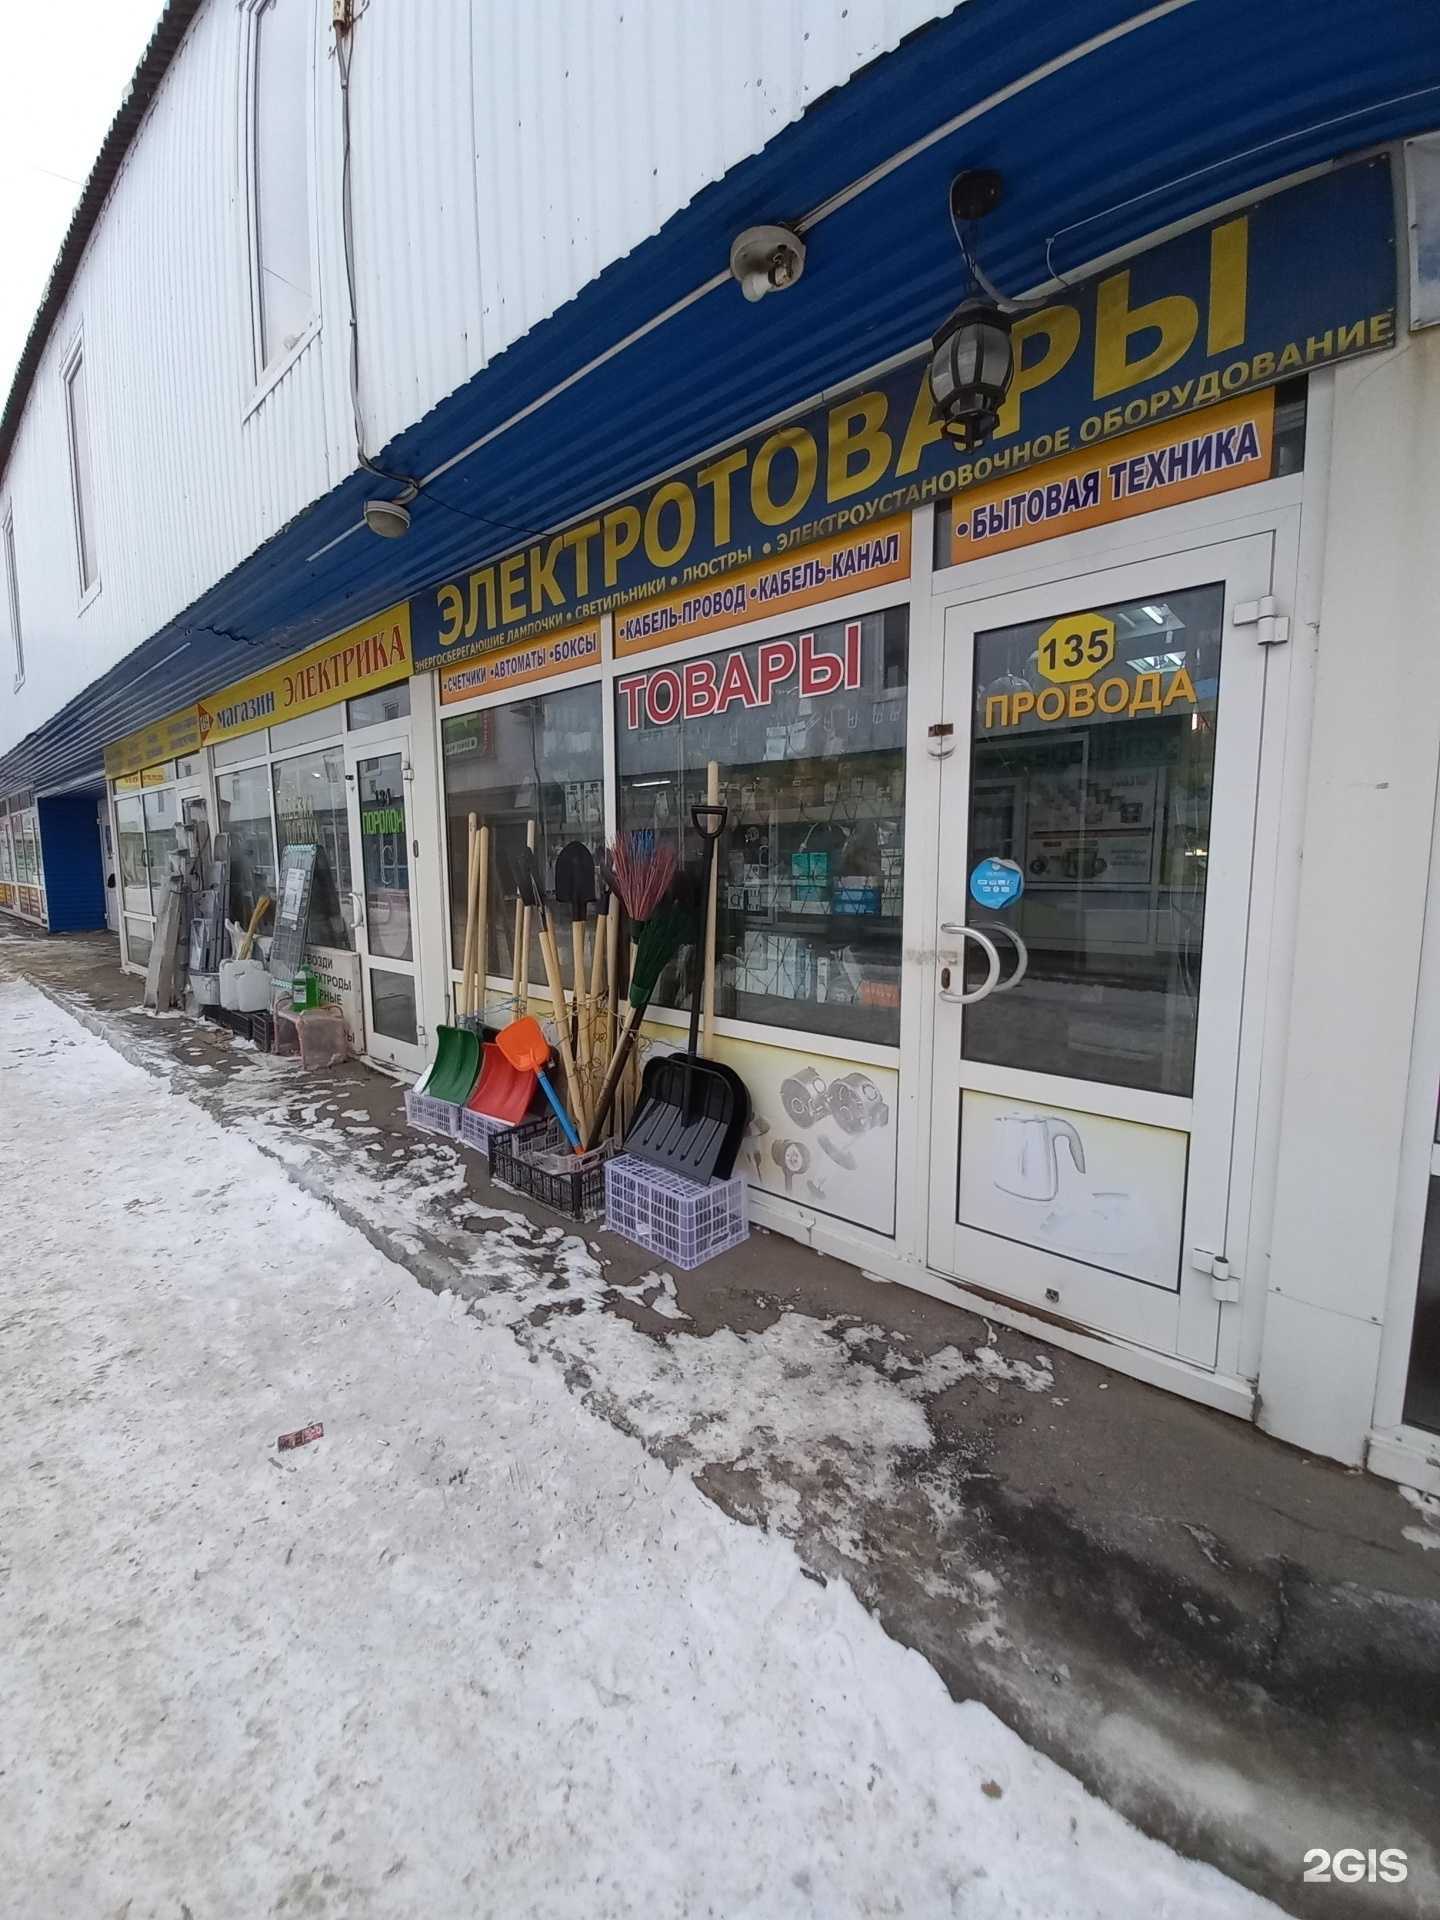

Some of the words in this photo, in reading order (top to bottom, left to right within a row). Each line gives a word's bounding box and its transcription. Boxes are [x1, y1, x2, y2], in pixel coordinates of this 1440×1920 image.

[436, 214, 1249, 648] ЭЛЕКТРОТОВАРЫ
[506, 613, 564, 645] ЛАМПОЧКИ
[575, 577, 667, 617] СВЕТИЛЬНИКИ
[680, 545, 752, 586] ЛЮСТРЫ
[775, 426, 1070, 552] ЭЛЕКТРОУСТАНОВОЧНОЕ
[1079, 312, 1393, 441] ОБОРУДОВАНИЕ
[971, 467, 1102, 541] БЫТОВАЯ
[1108, 419, 1262, 500] ТЕХНИКА
[758, 532, 900, 602] КАБЕЛЬ-КАНАЛ
[215, 690, 276, 730] магазин
[282, 622, 408, 708] ЭЛЕКТРИКА
[447, 666, 487, 694] СЧЕТЧИКИ
[493, 649, 547, 680] АВТОМАТЫ
[553, 634, 598, 663] БОКСЫ
[619, 621, 862, 732] ТОВАРЫ
[1042, 628, 1108, 671] 135
[985, 667, 1198, 729] ПРОВОДА
[362, 807, 405, 835] ПОРОЛОН
